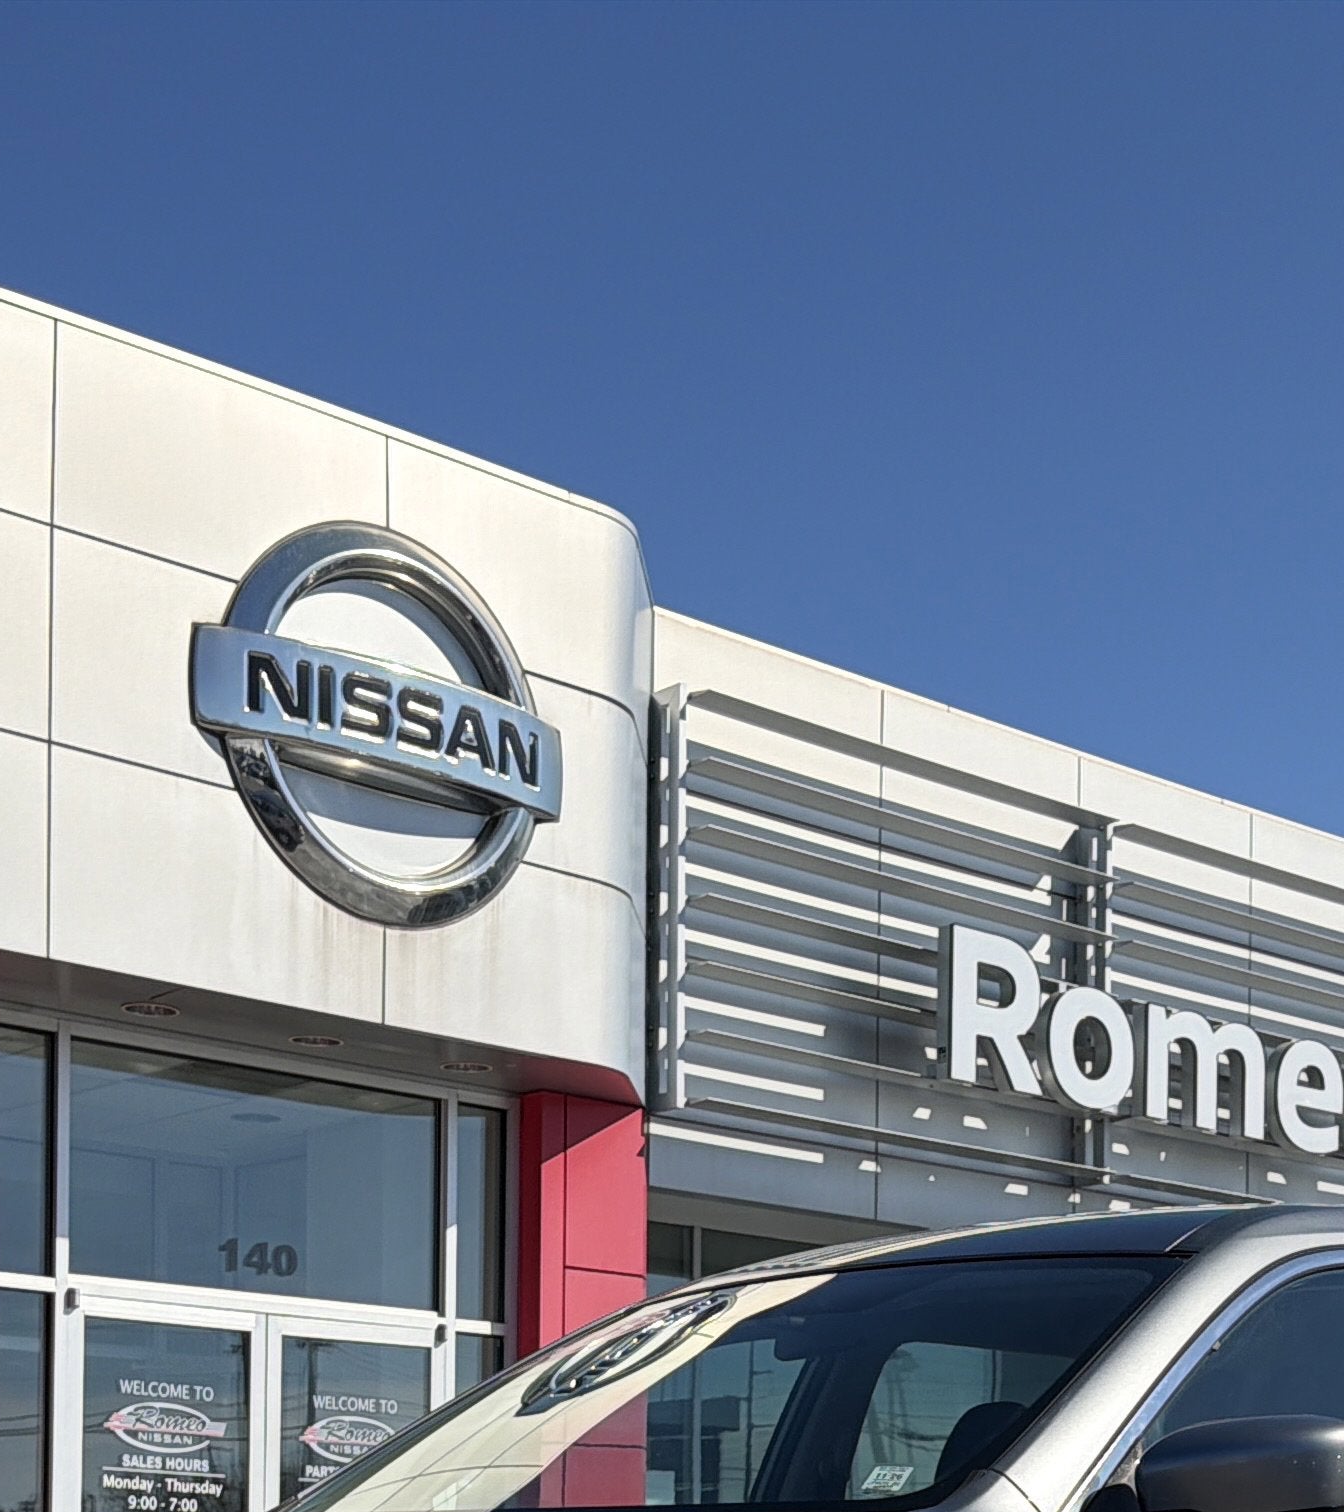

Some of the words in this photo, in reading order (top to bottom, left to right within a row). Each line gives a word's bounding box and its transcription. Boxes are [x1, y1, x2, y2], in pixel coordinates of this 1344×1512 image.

[246, 650, 541, 792] NISSAN
[218, 1238, 298, 1277] 140
[119, 1378, 190, 1400] WELCOME
[194, 1385, 214, 1402] TO
[312, 1395, 377, 1413] WELCOME
[378, 1399, 398, 1414] TO
[127, 1405, 207, 1432] Romeo
[137, 1432, 193, 1445] NISSAN
[122, 1453, 163, 1469] SALES
[165, 1456, 210, 1472] HOURS
[102, 1473, 155, 1494] Monday
[164, 1477, 224, 1498] Thursday
[127, 1495, 157, 1511] 9:00
[169, 1497, 198, 1512] 7:00
